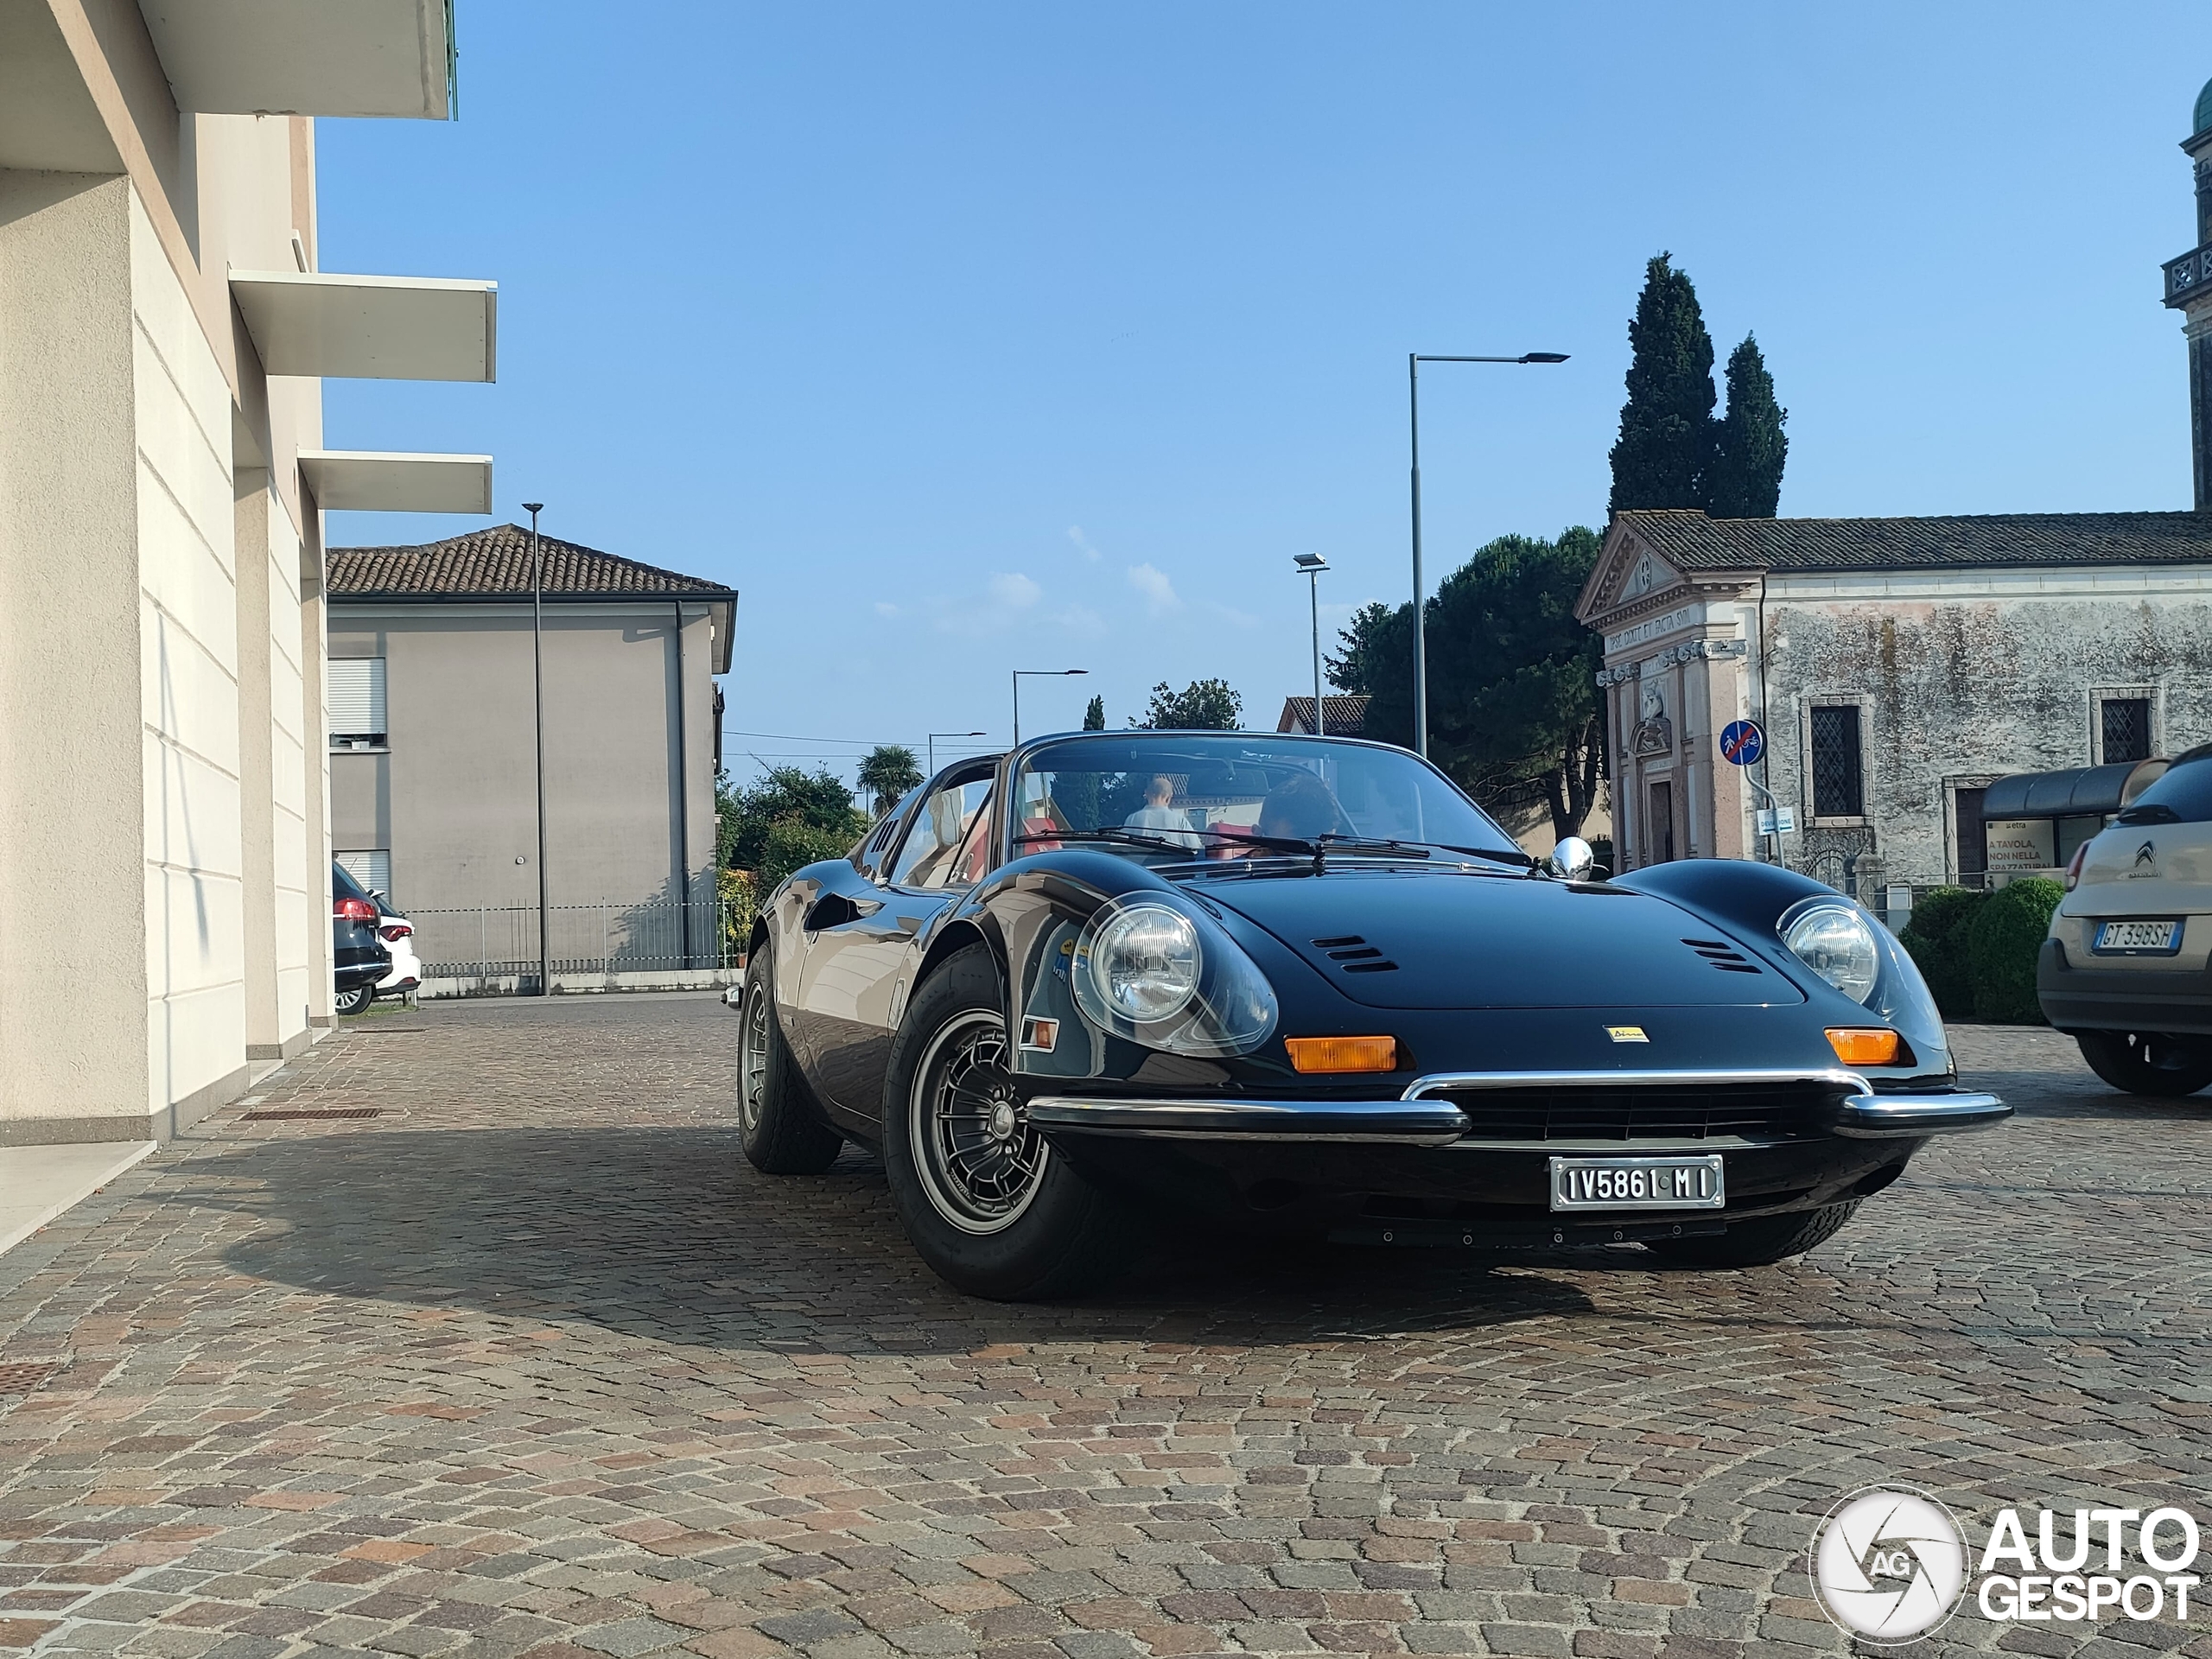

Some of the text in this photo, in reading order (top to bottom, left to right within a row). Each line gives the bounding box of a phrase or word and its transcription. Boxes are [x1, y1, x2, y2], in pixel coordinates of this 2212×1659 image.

[1643, 622, 1652, 639] ET
[1760, 817, 1791, 827] DEVIIONE
[1996, 839, 2036, 849] TAVOLA,
[1989, 851, 2041, 861] NON NELLA
